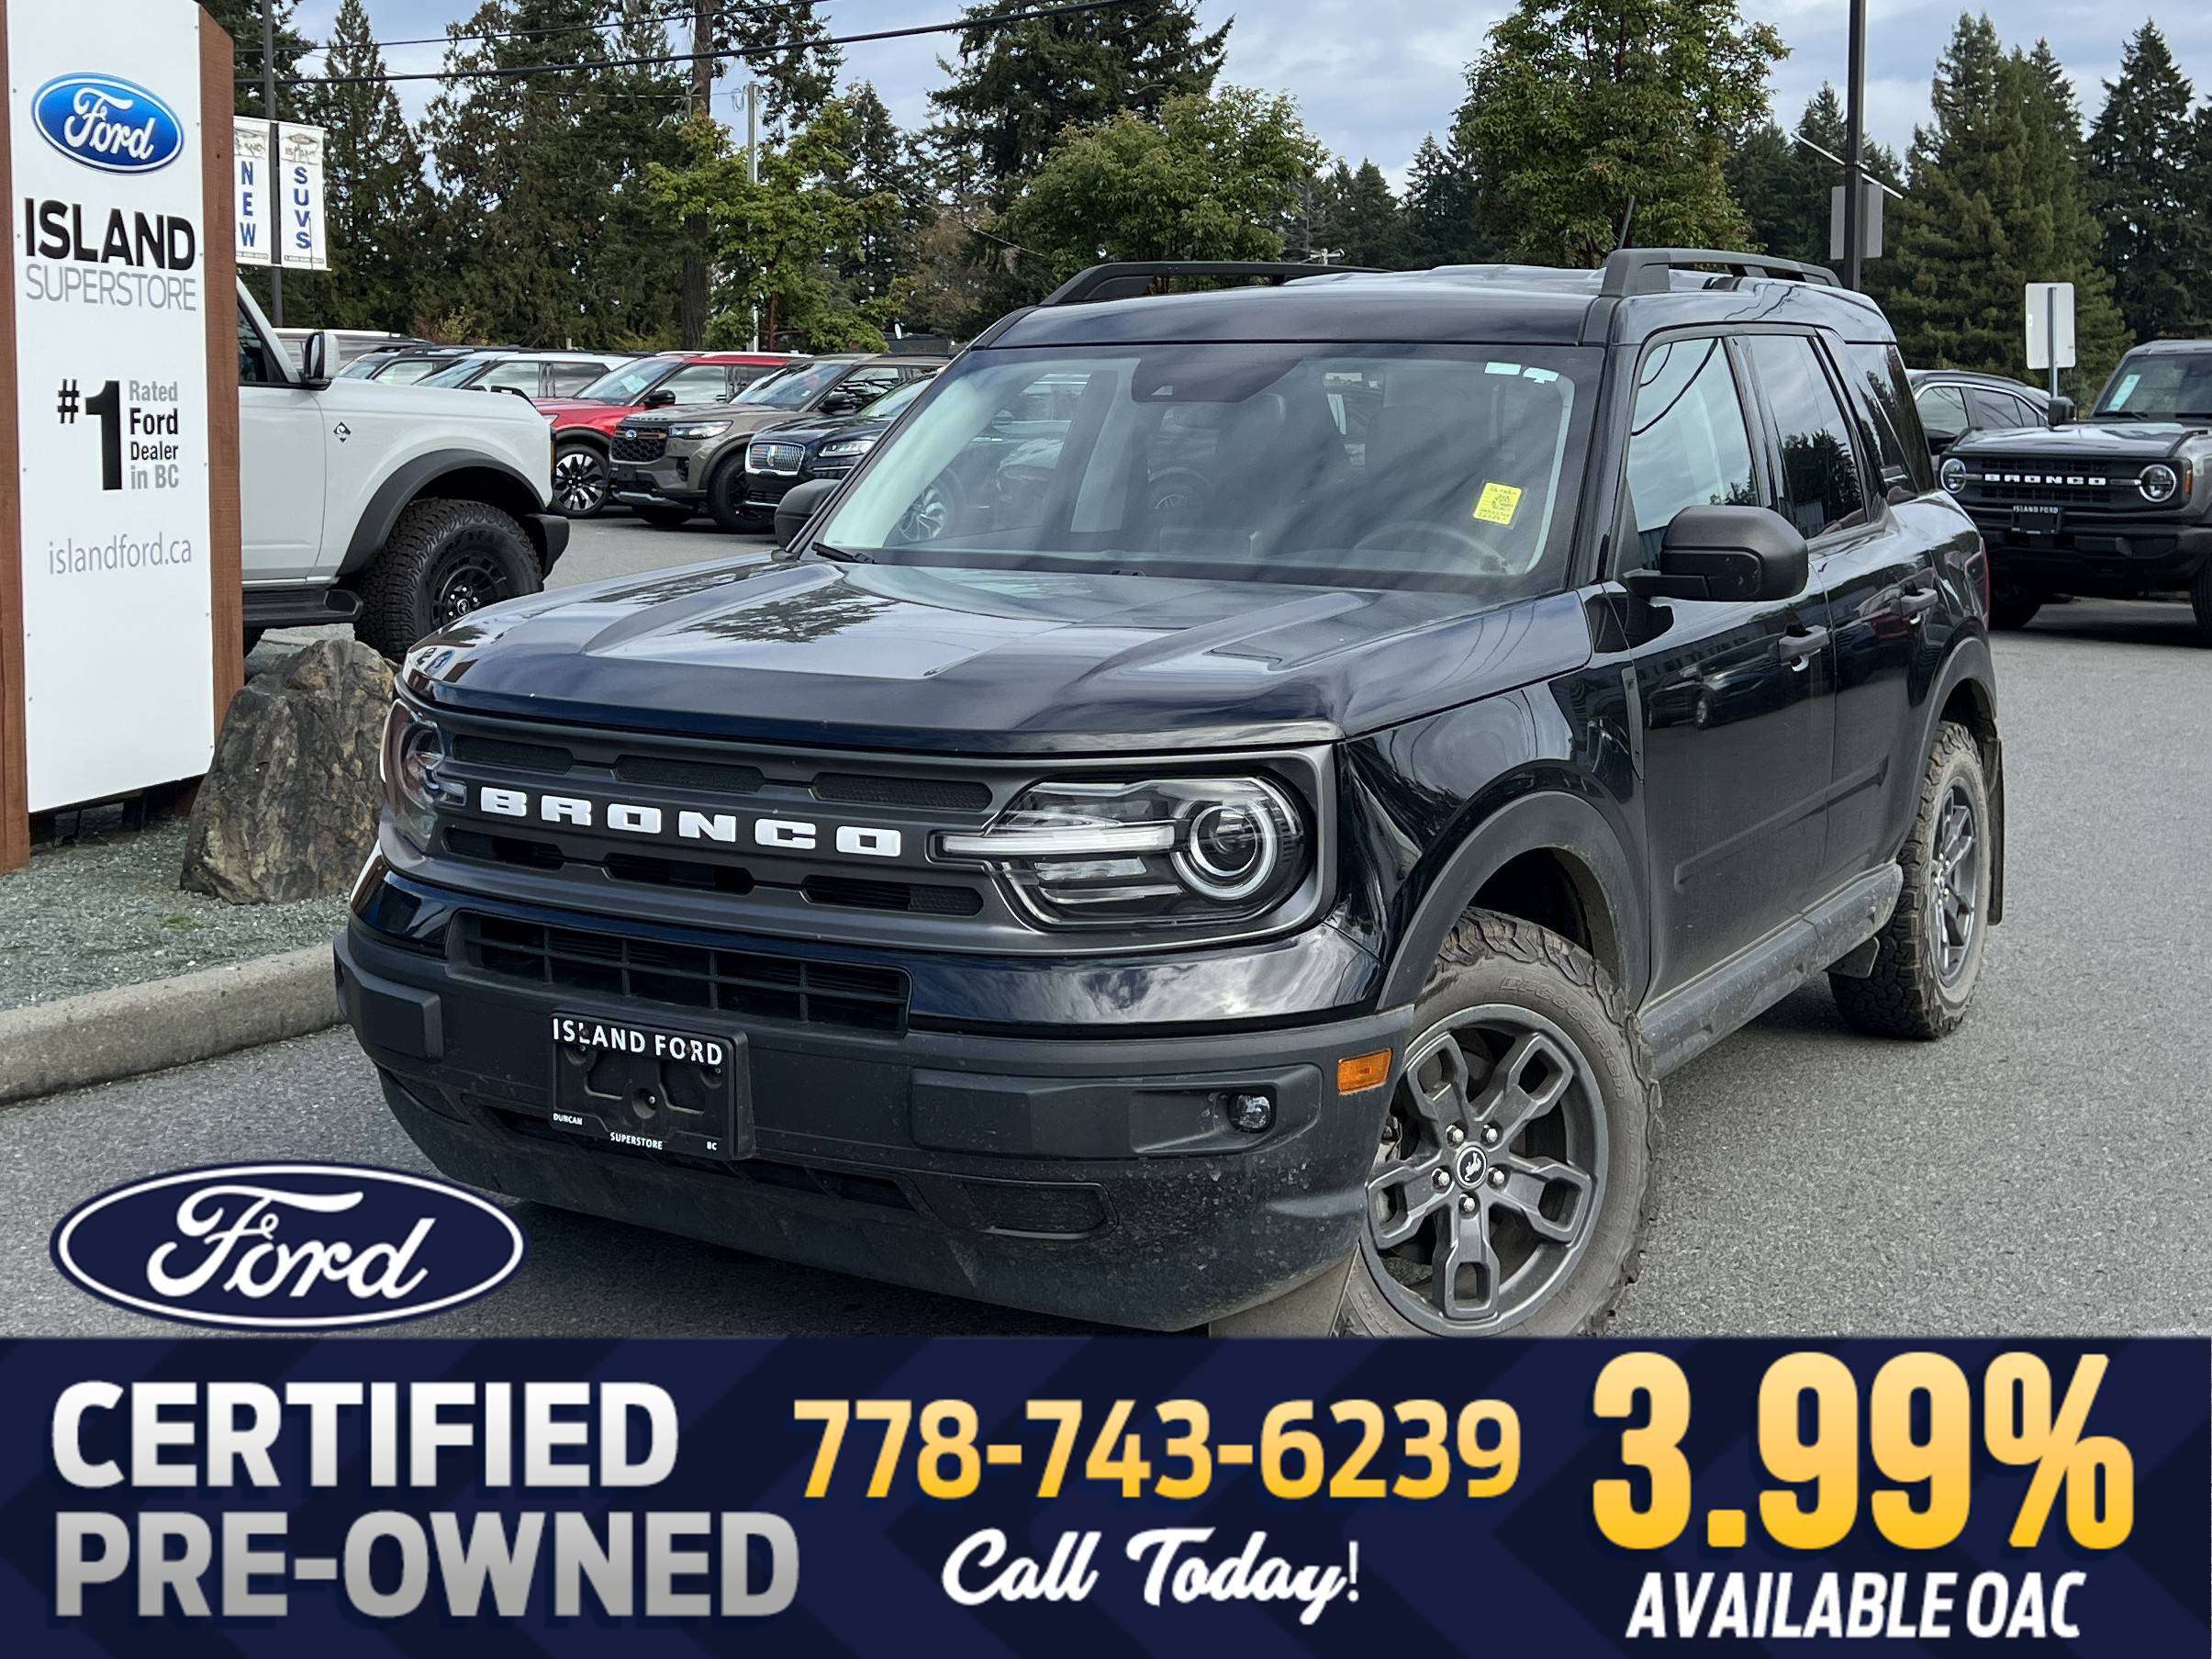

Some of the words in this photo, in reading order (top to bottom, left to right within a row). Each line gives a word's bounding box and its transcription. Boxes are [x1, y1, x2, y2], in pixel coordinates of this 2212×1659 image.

[64, 87, 156, 160] Ford
[240, 161, 256, 247] NEW
[293, 166, 312, 249] SUVS
[25, 197, 196, 271] ISLAND
[26, 263, 196, 311] SUPERSTORE
[129, 380, 178, 401] Rated
[58, 379, 122, 490] #1
[129, 408, 178, 434] Ford
[130, 441, 179, 460] Dealer
[130, 465, 148, 489] in
[155, 464, 179, 488] BC
[1984, 474, 2106, 486] BRONCO
[50, 532, 192, 575] islandford.ca
[481, 786, 901, 858] BRONCO
[553, 1018, 646, 1053] ISLAND
[654, 1035, 722, 1066] FORD
[553, 1113, 583, 1126] DUNCAN
[609, 1131, 663, 1150] SUPERSTORE
